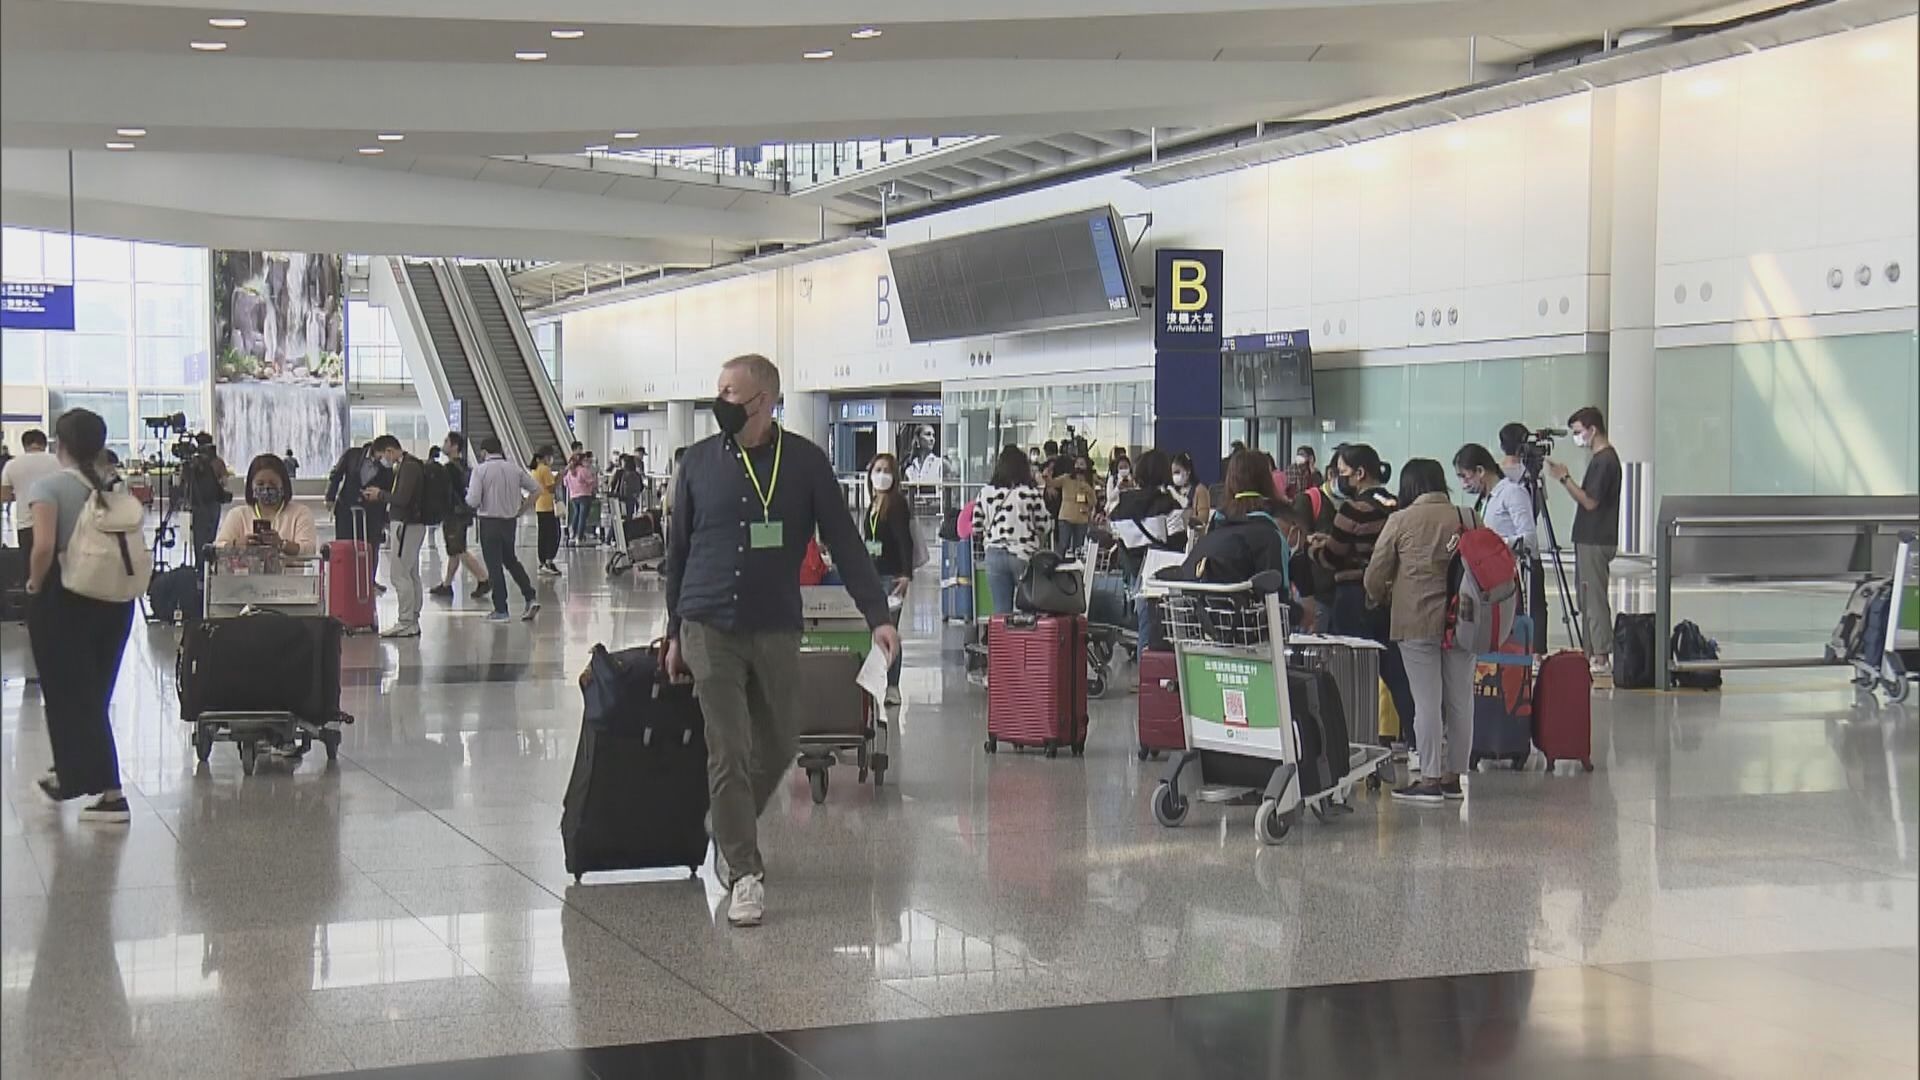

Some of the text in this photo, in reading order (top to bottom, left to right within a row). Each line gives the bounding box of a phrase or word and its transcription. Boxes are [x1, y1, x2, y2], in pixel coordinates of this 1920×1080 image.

[1172, 259, 1208, 311] B
[877, 275, 890, 326] B
[1108, 296, 1127, 310] Hall B
[1166, 312, 1214, 325] 接機大堂
[1166, 325, 1214, 333] Arrivals Hall
